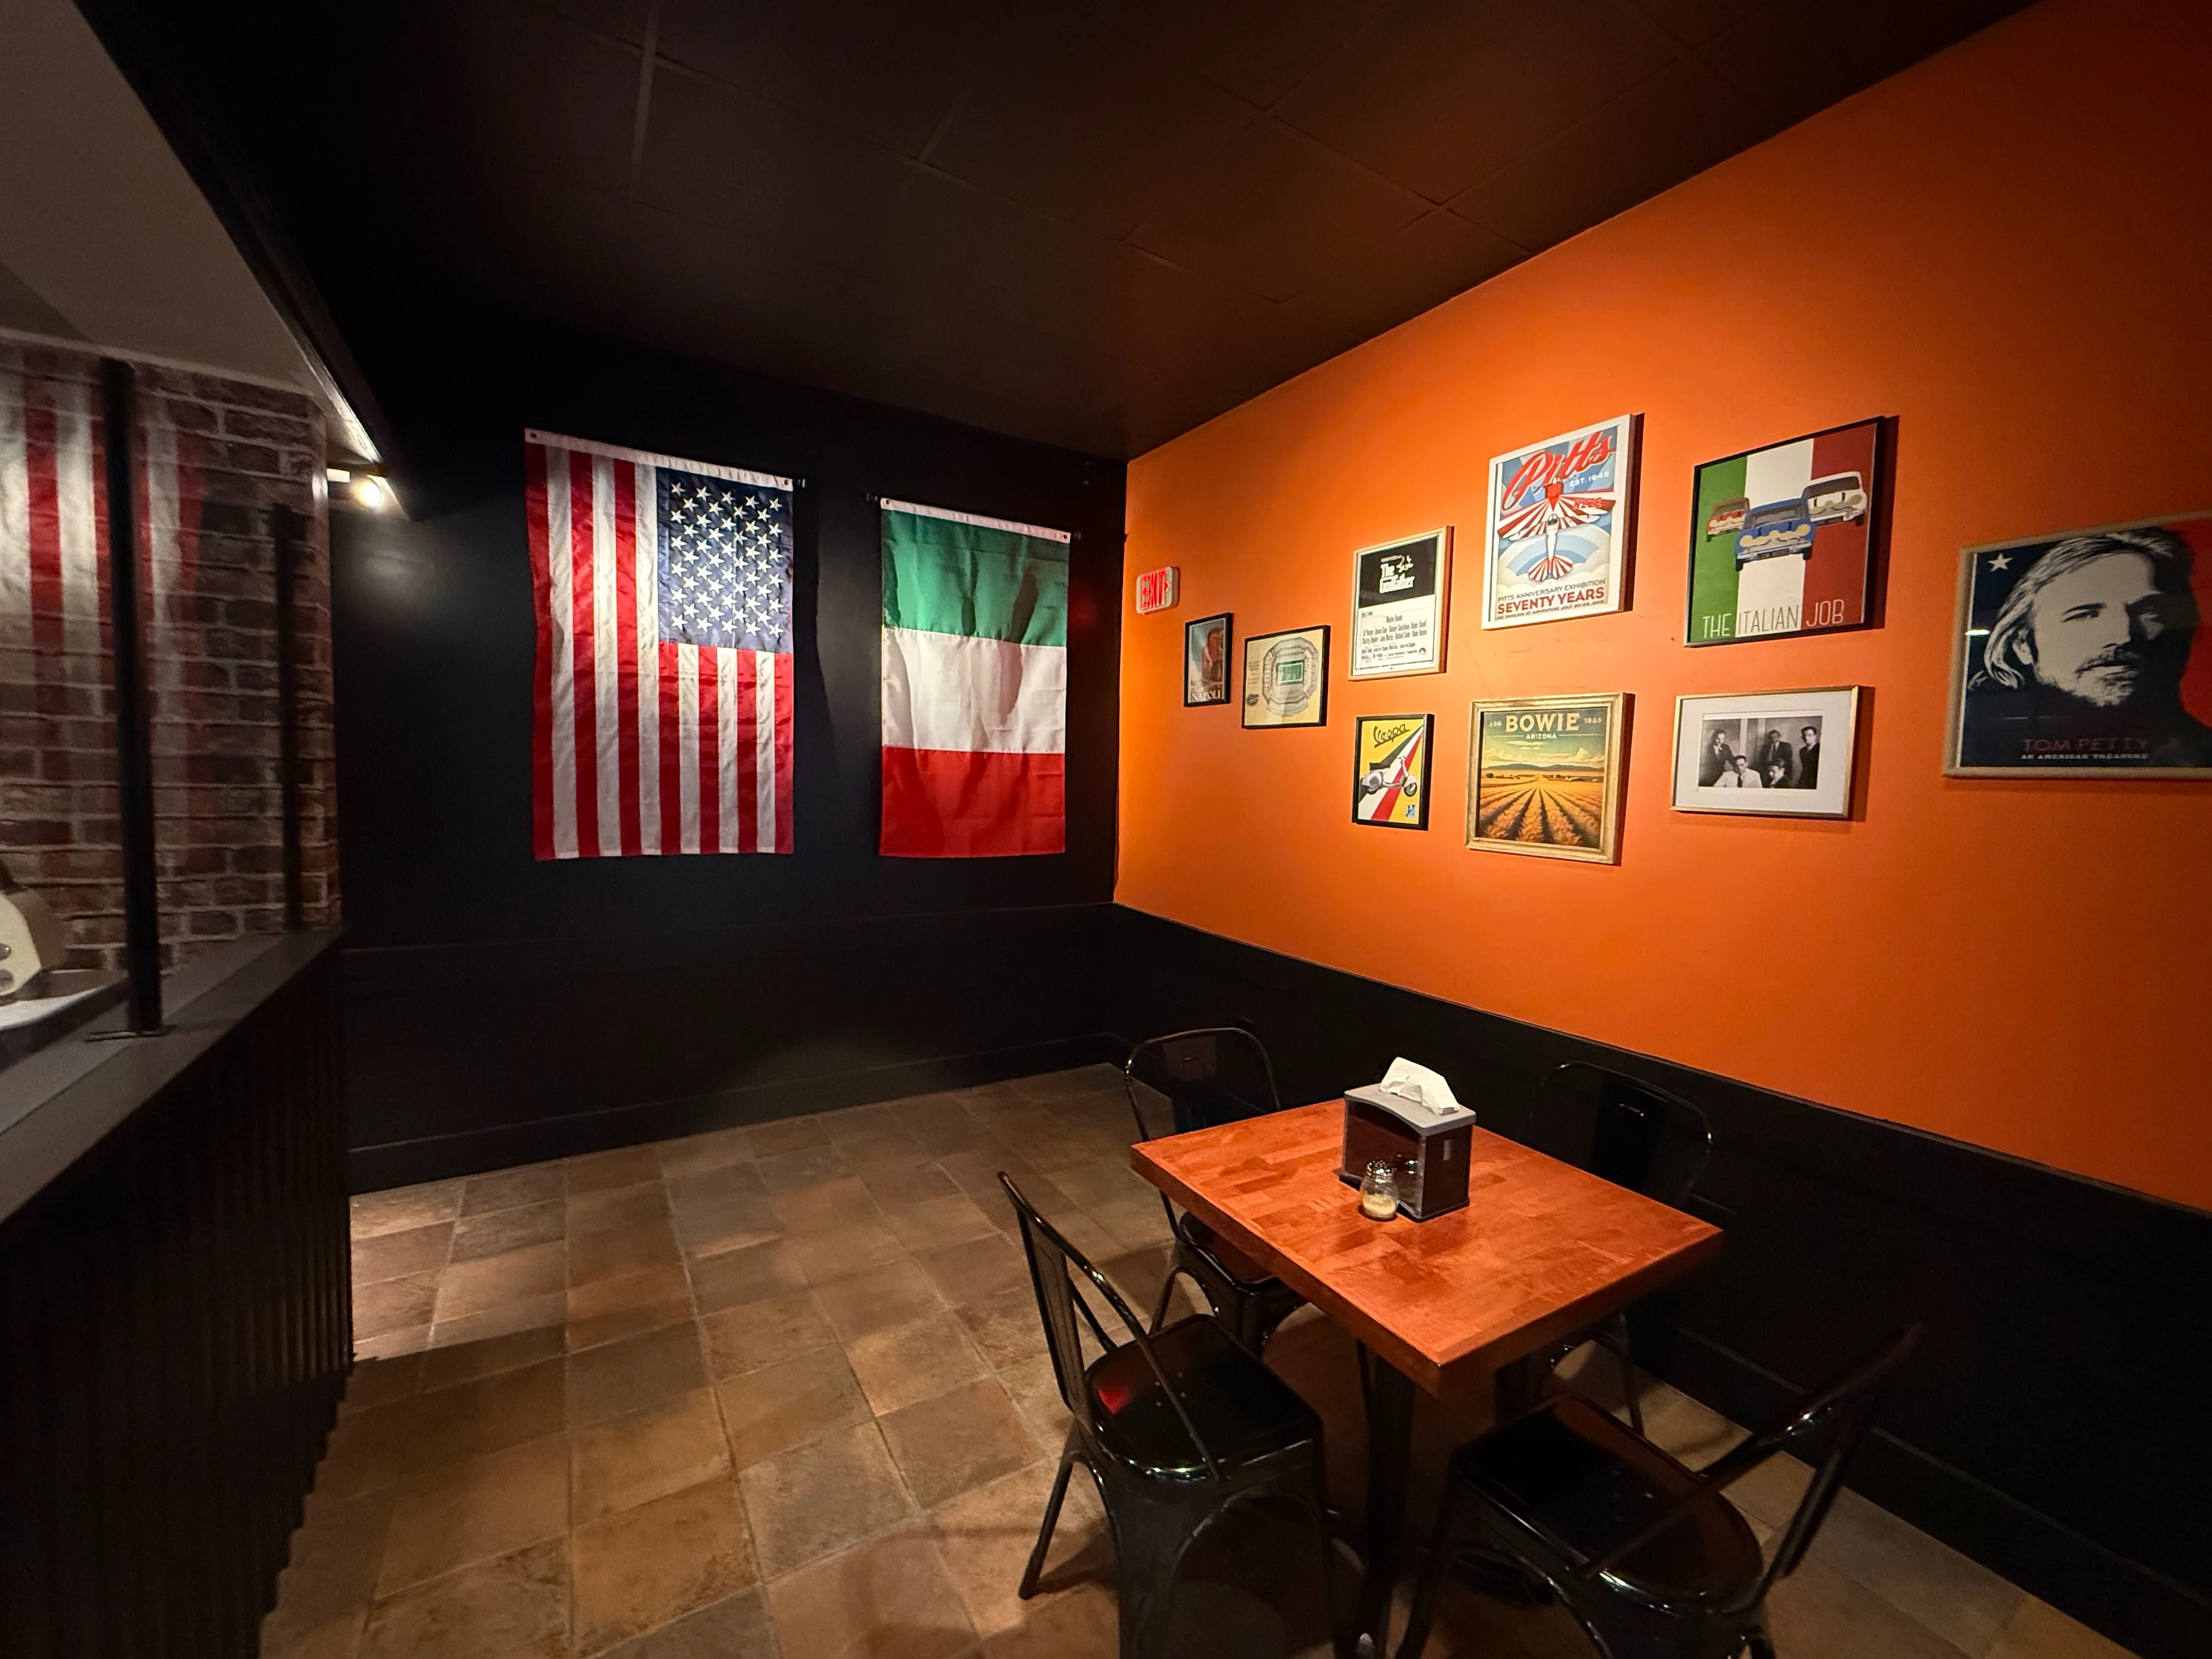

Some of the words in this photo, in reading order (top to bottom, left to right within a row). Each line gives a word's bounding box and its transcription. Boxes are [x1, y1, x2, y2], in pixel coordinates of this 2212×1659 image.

[1502, 431, 1616, 511] Pitts
[1380, 563, 1395, 578] The
[1142, 568, 1167, 610] EXIT
[1497, 595, 1555, 614] SEVENTY
[1558, 586, 1605, 605] YEARS
[1498, 594, 1514, 603] PITTS
[1516, 586, 1563, 599] ANNIVERSARY
[1564, 578, 1606, 591] EXHIBITION
[1702, 613, 1732, 639] THE
[1738, 605, 1799, 635] ITALIAN
[1806, 599, 1844, 627] JOB
[1190, 689, 1221, 702] NAPOLI
[1373, 723, 1410, 746] Vespa
[1505, 713, 1580, 732] BOWIE
[2021, 738, 2070, 752] TOM
[2077, 738, 2149, 752] PETTY
